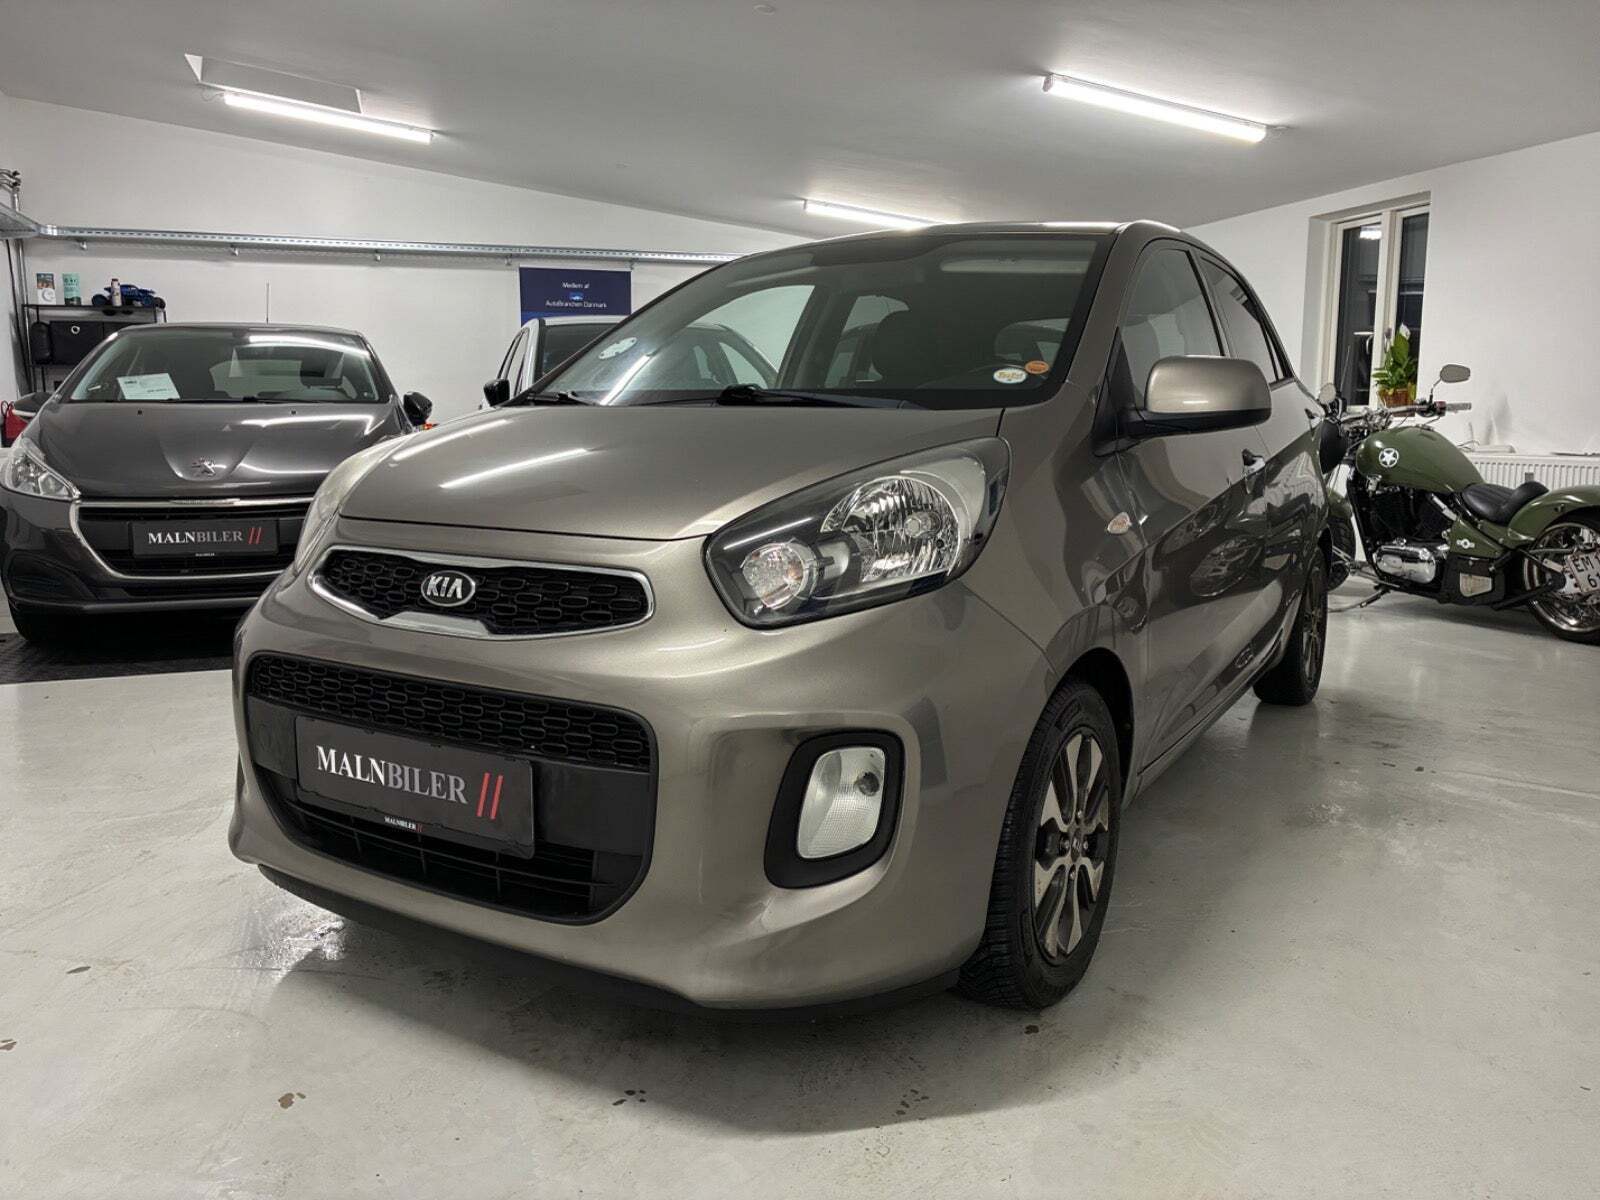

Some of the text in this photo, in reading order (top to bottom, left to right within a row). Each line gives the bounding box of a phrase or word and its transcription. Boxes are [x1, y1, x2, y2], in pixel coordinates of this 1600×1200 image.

[148, 531, 243, 544] MALNBILER
[426, 575, 462, 599] KIA
[316, 745, 468, 805] MALNBILER
